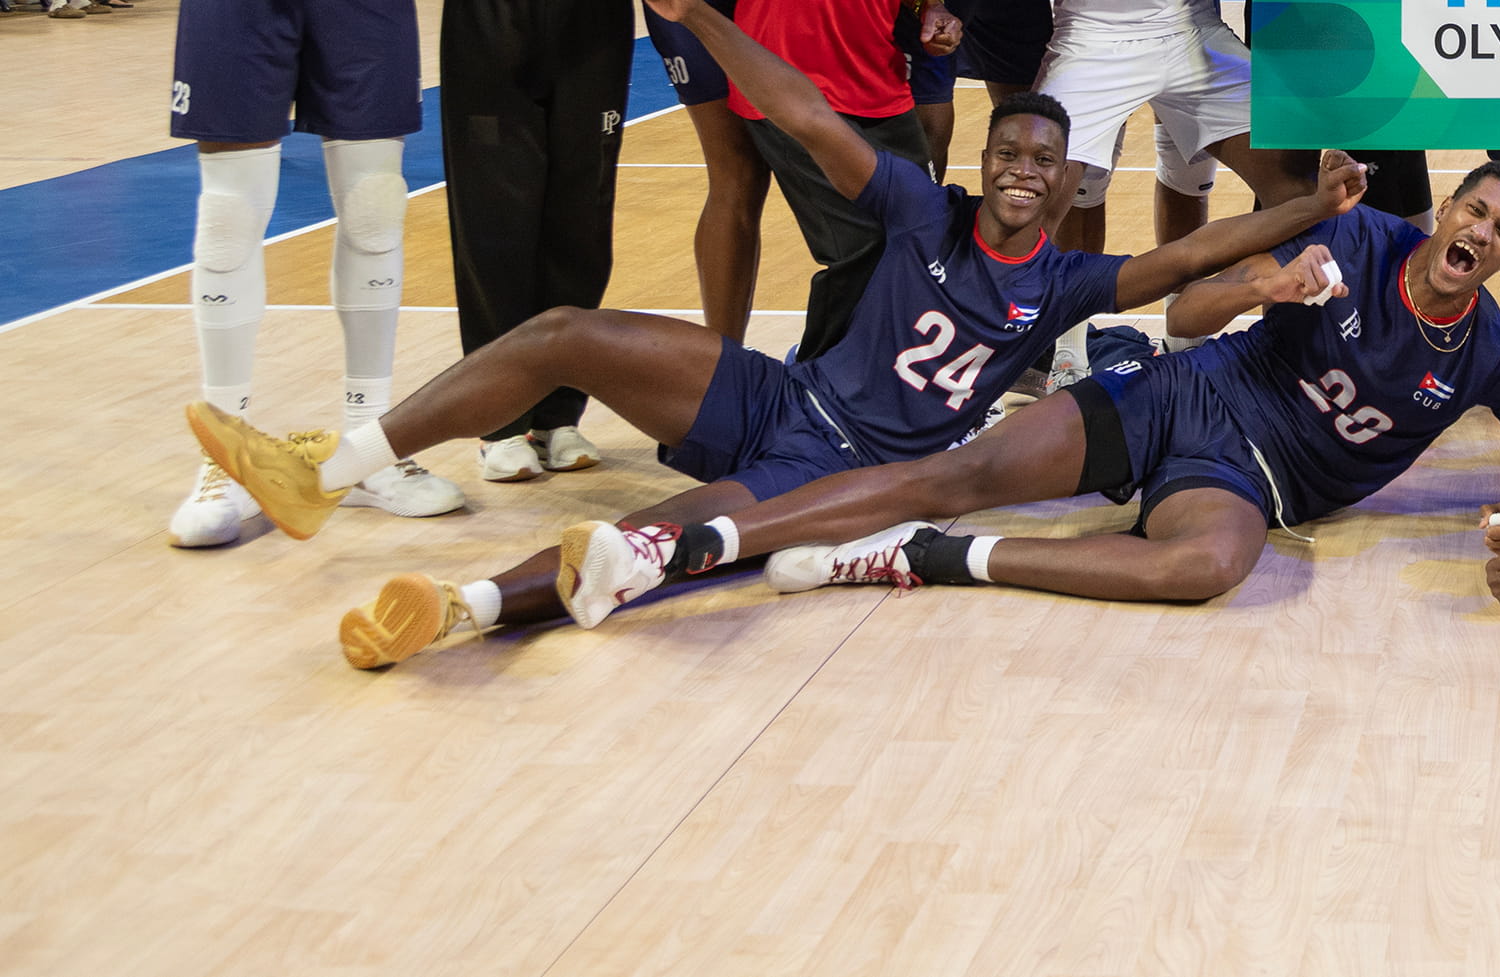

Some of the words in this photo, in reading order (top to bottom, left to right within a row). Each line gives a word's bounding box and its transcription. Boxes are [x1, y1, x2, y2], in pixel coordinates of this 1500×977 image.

[172, 79, 192, 116] 23
[893, 309, 996, 412] 24
[1413, 390, 1442, 410] CUB
